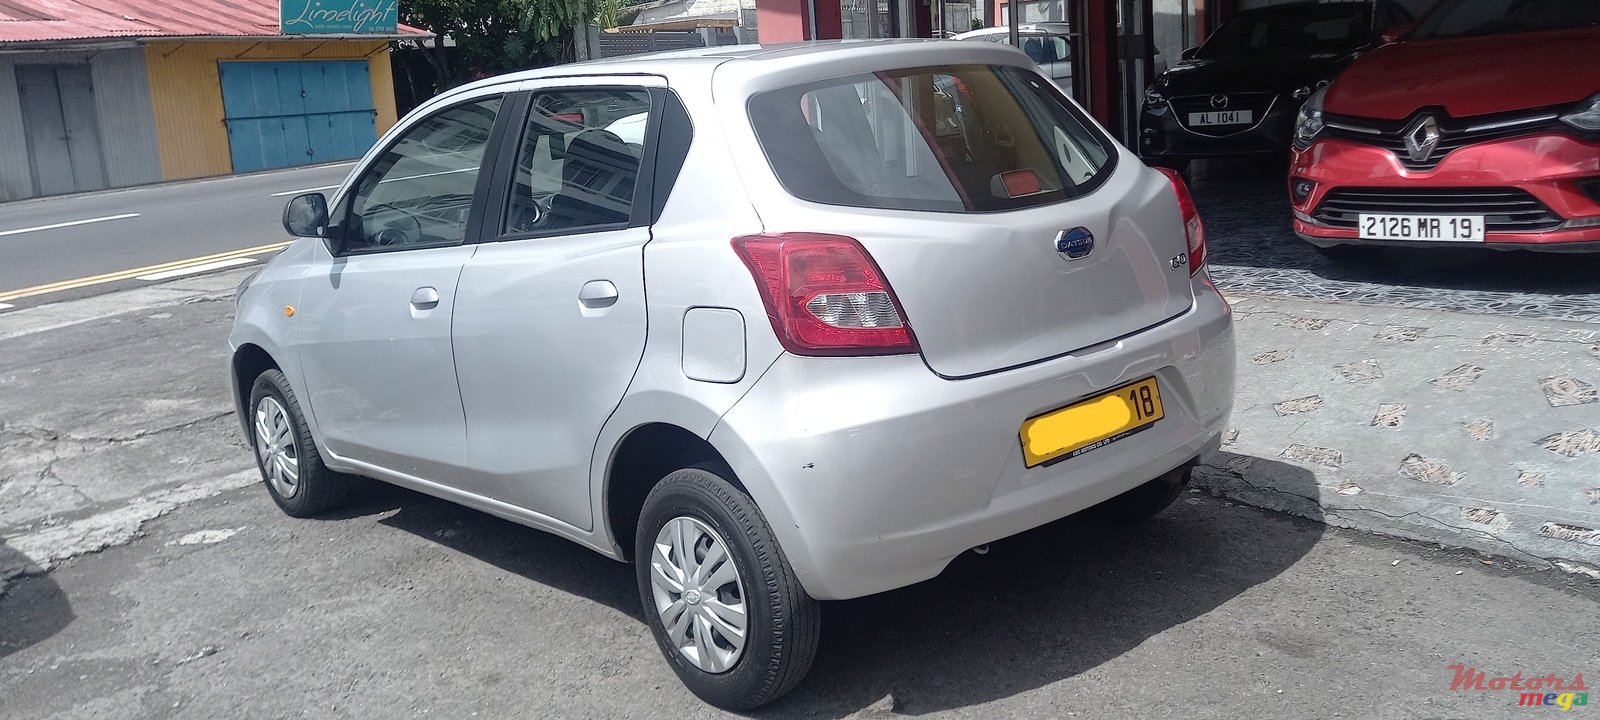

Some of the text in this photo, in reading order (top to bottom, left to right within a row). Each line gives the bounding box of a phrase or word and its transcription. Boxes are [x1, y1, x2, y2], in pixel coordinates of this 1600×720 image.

[285, 0, 395, 32] Limelight
[1200, 112, 1239, 124] AL 1041
[1366, 217, 1472, 238] 2126 MR 19
[1060, 236, 1093, 250] DATSUN
[1129, 384, 1155, 421] 18
